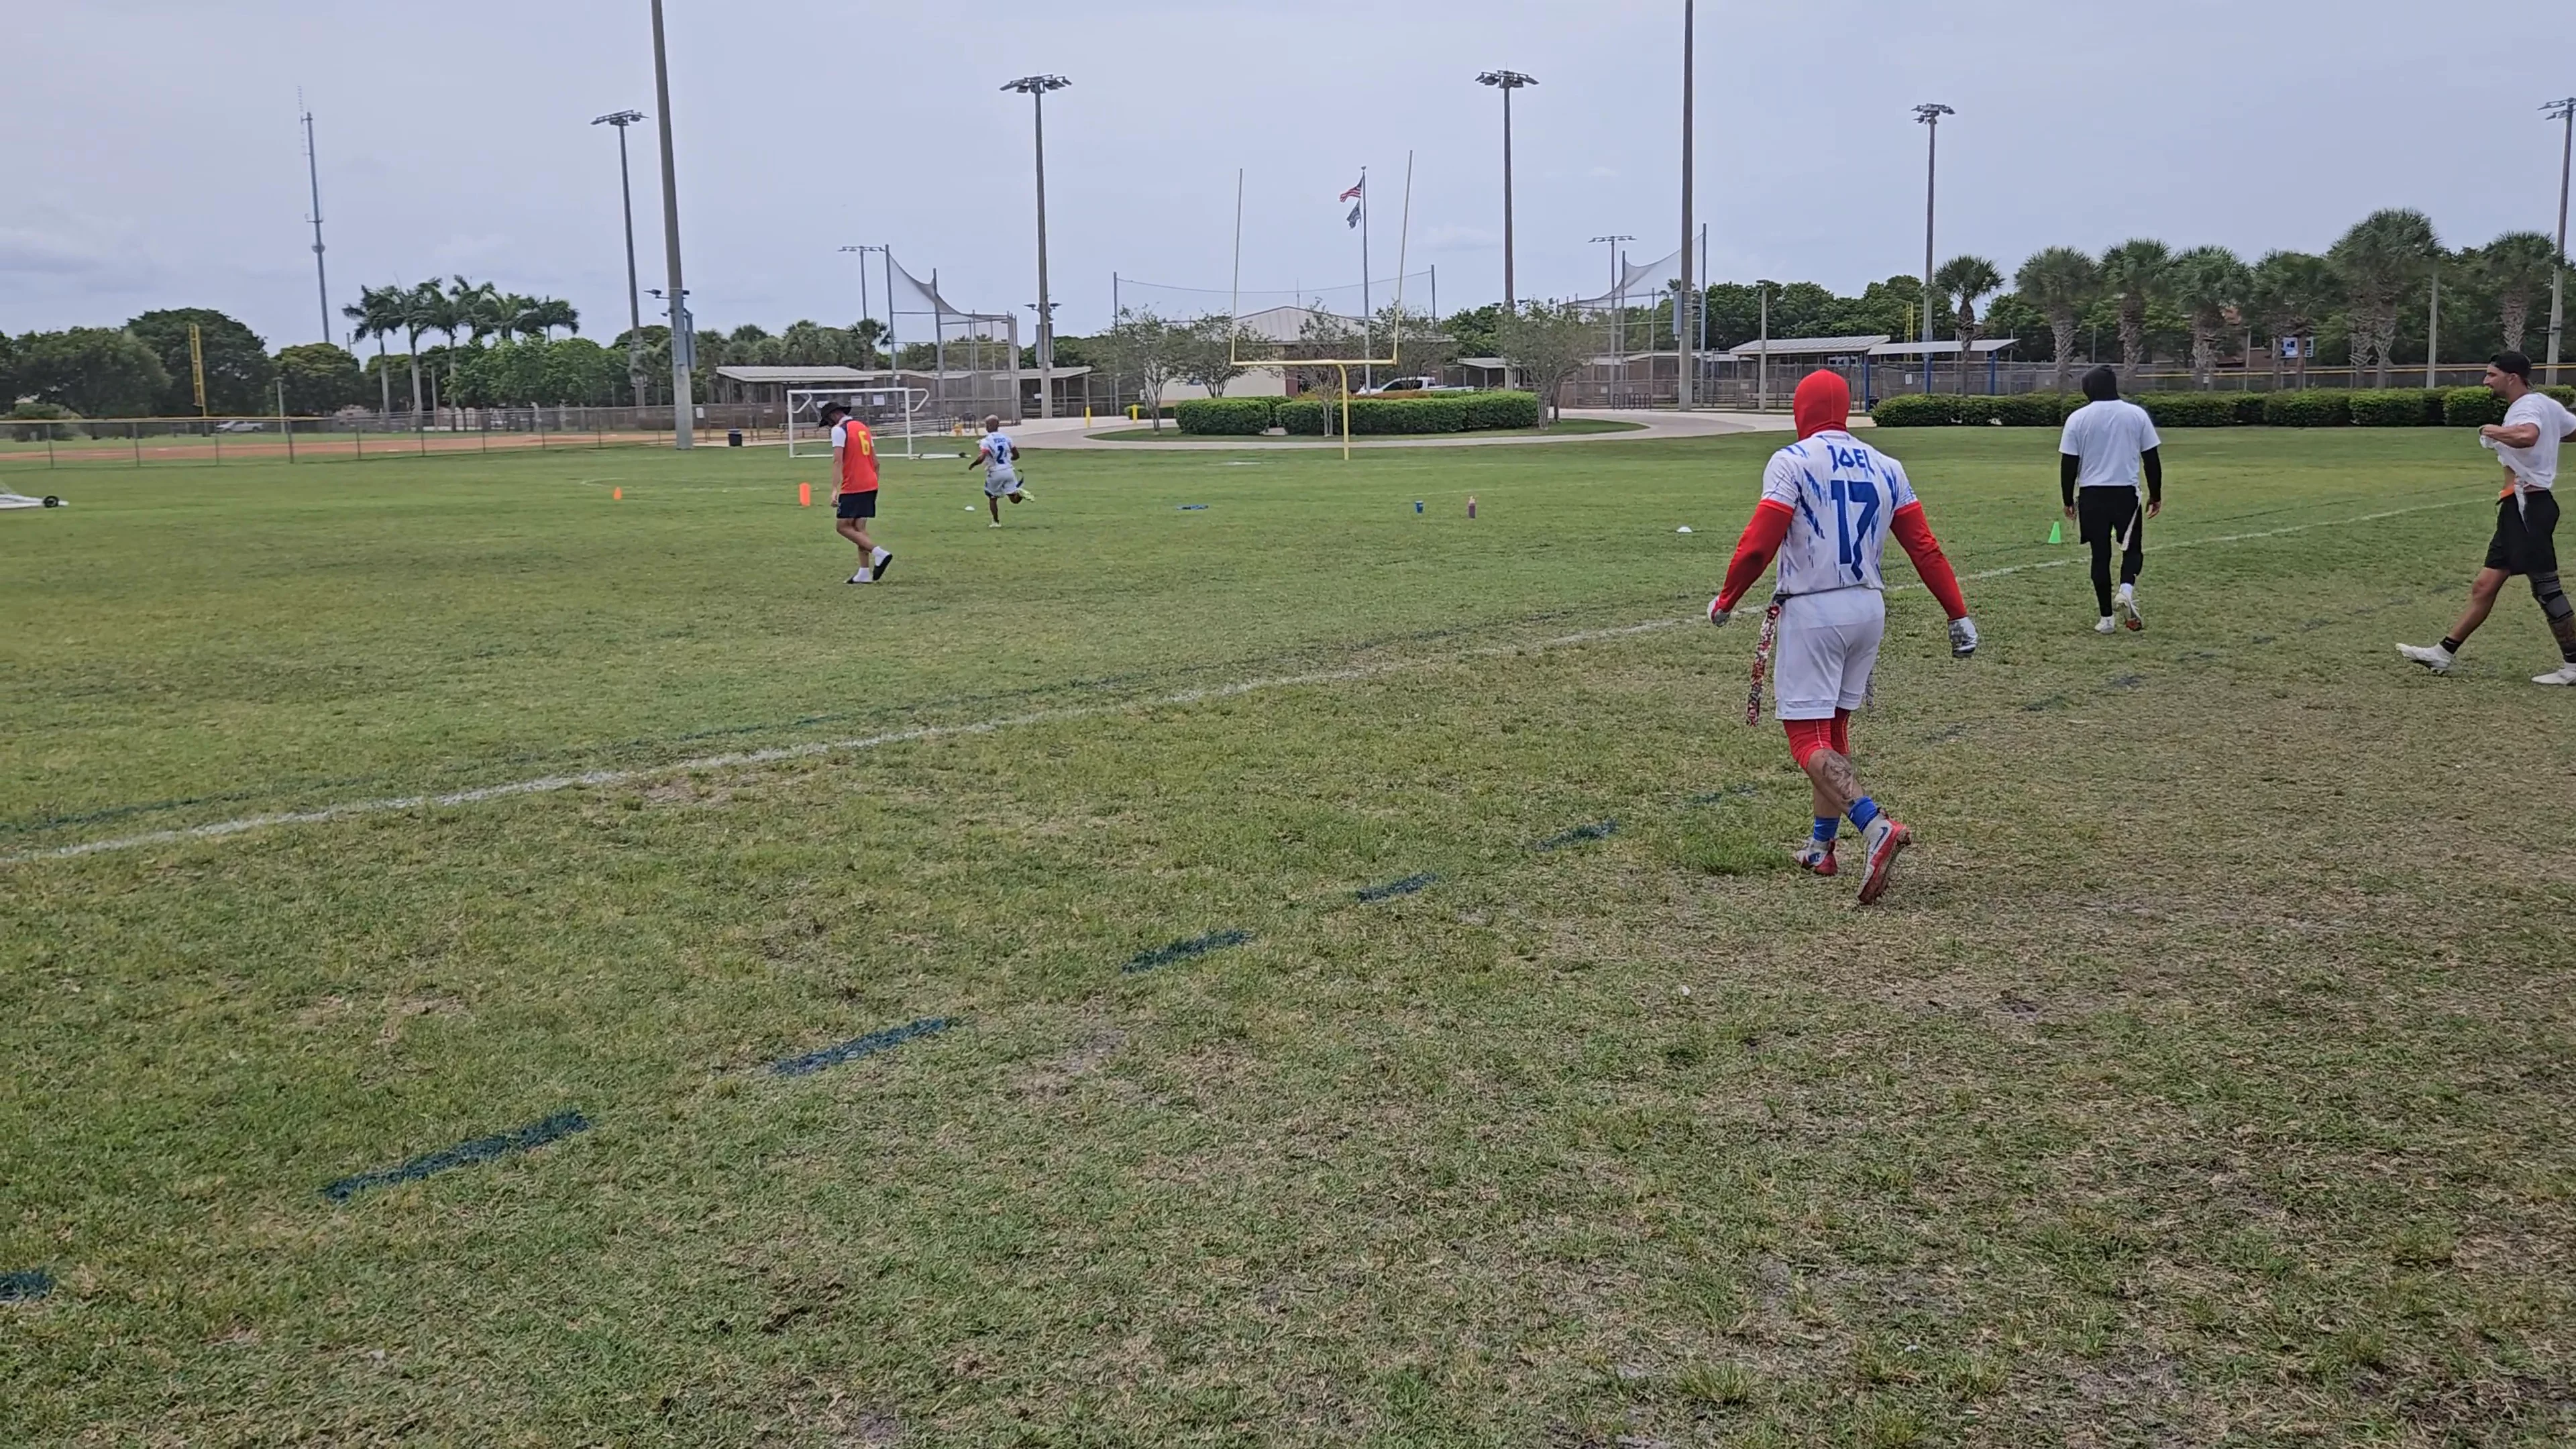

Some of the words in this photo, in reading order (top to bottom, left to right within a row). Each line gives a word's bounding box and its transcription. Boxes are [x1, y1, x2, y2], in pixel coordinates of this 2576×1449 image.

[858, 430, 870, 455] 6
[996, 445, 1005, 464] 2
[1827, 445, 1876, 476] JOEL
[1830, 480, 1880, 582] 17
